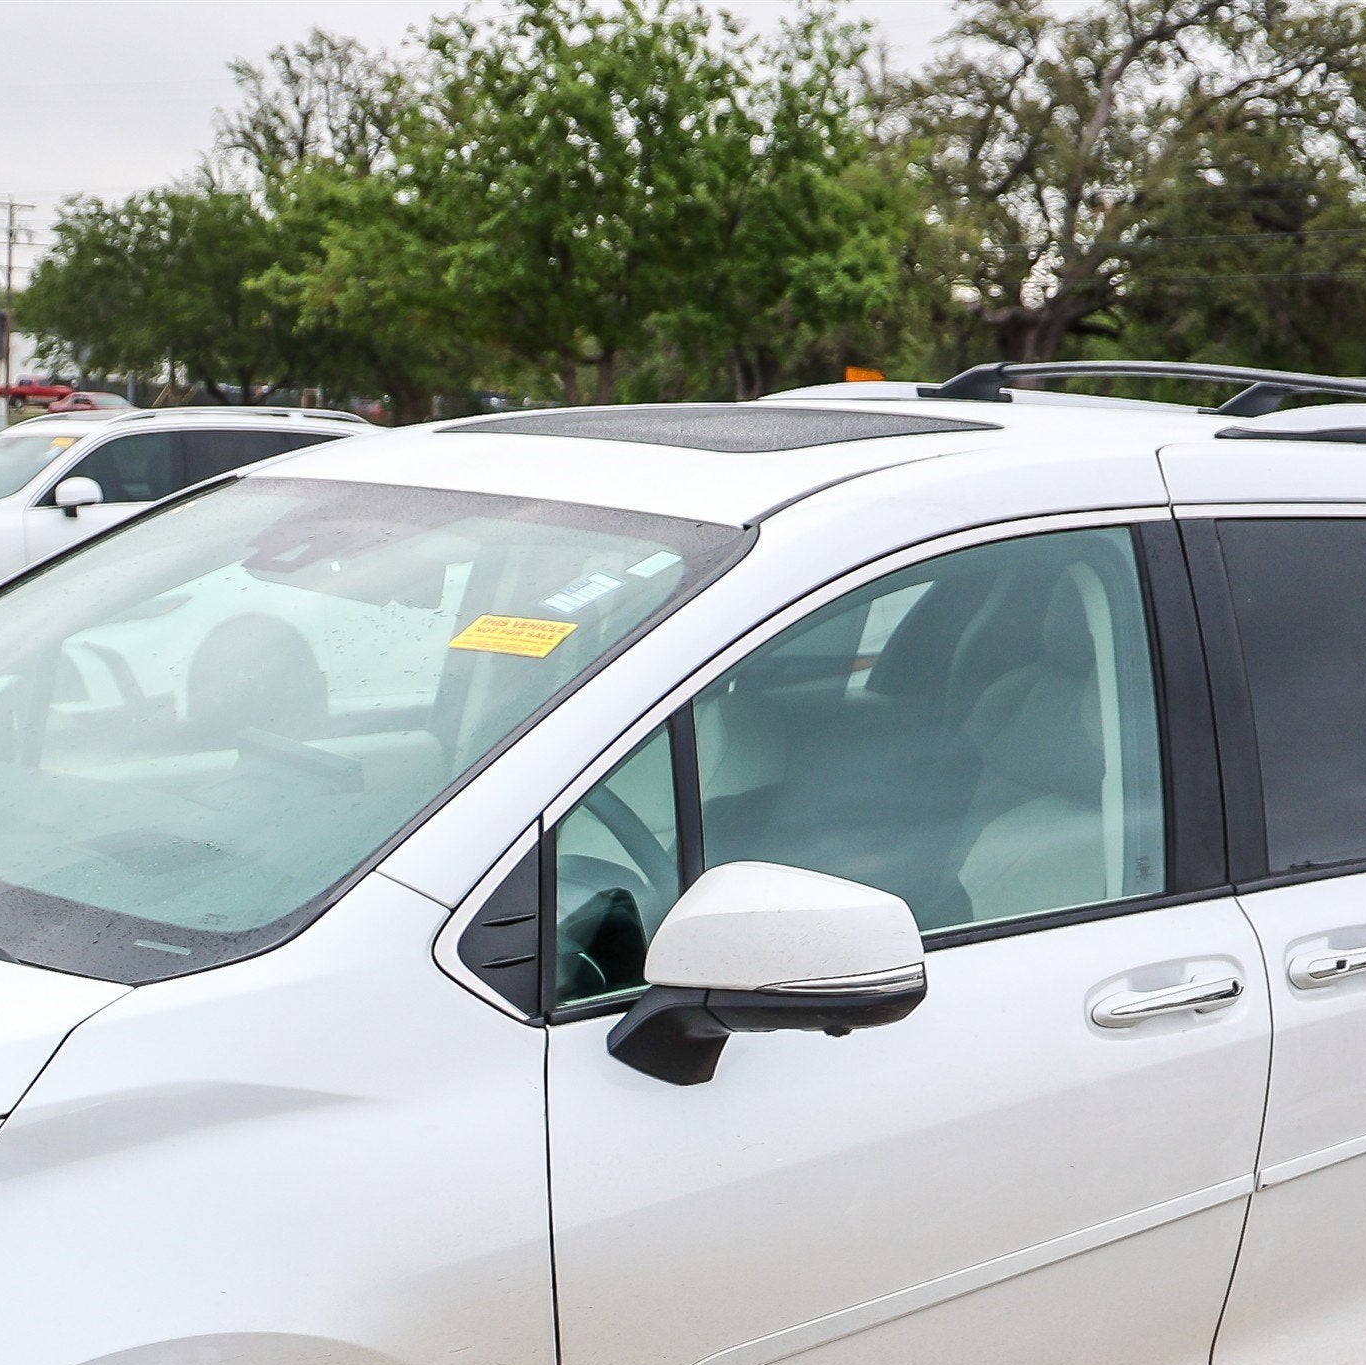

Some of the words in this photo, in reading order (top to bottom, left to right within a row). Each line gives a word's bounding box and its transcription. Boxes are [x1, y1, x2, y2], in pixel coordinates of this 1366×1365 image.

[475, 626, 498, 634] NOT
[499, 628, 524, 636] FOR
[526, 632, 559, 640] SALE
[481, 618, 509, 627] THIS
[512, 621, 570, 634] VEHICLE
